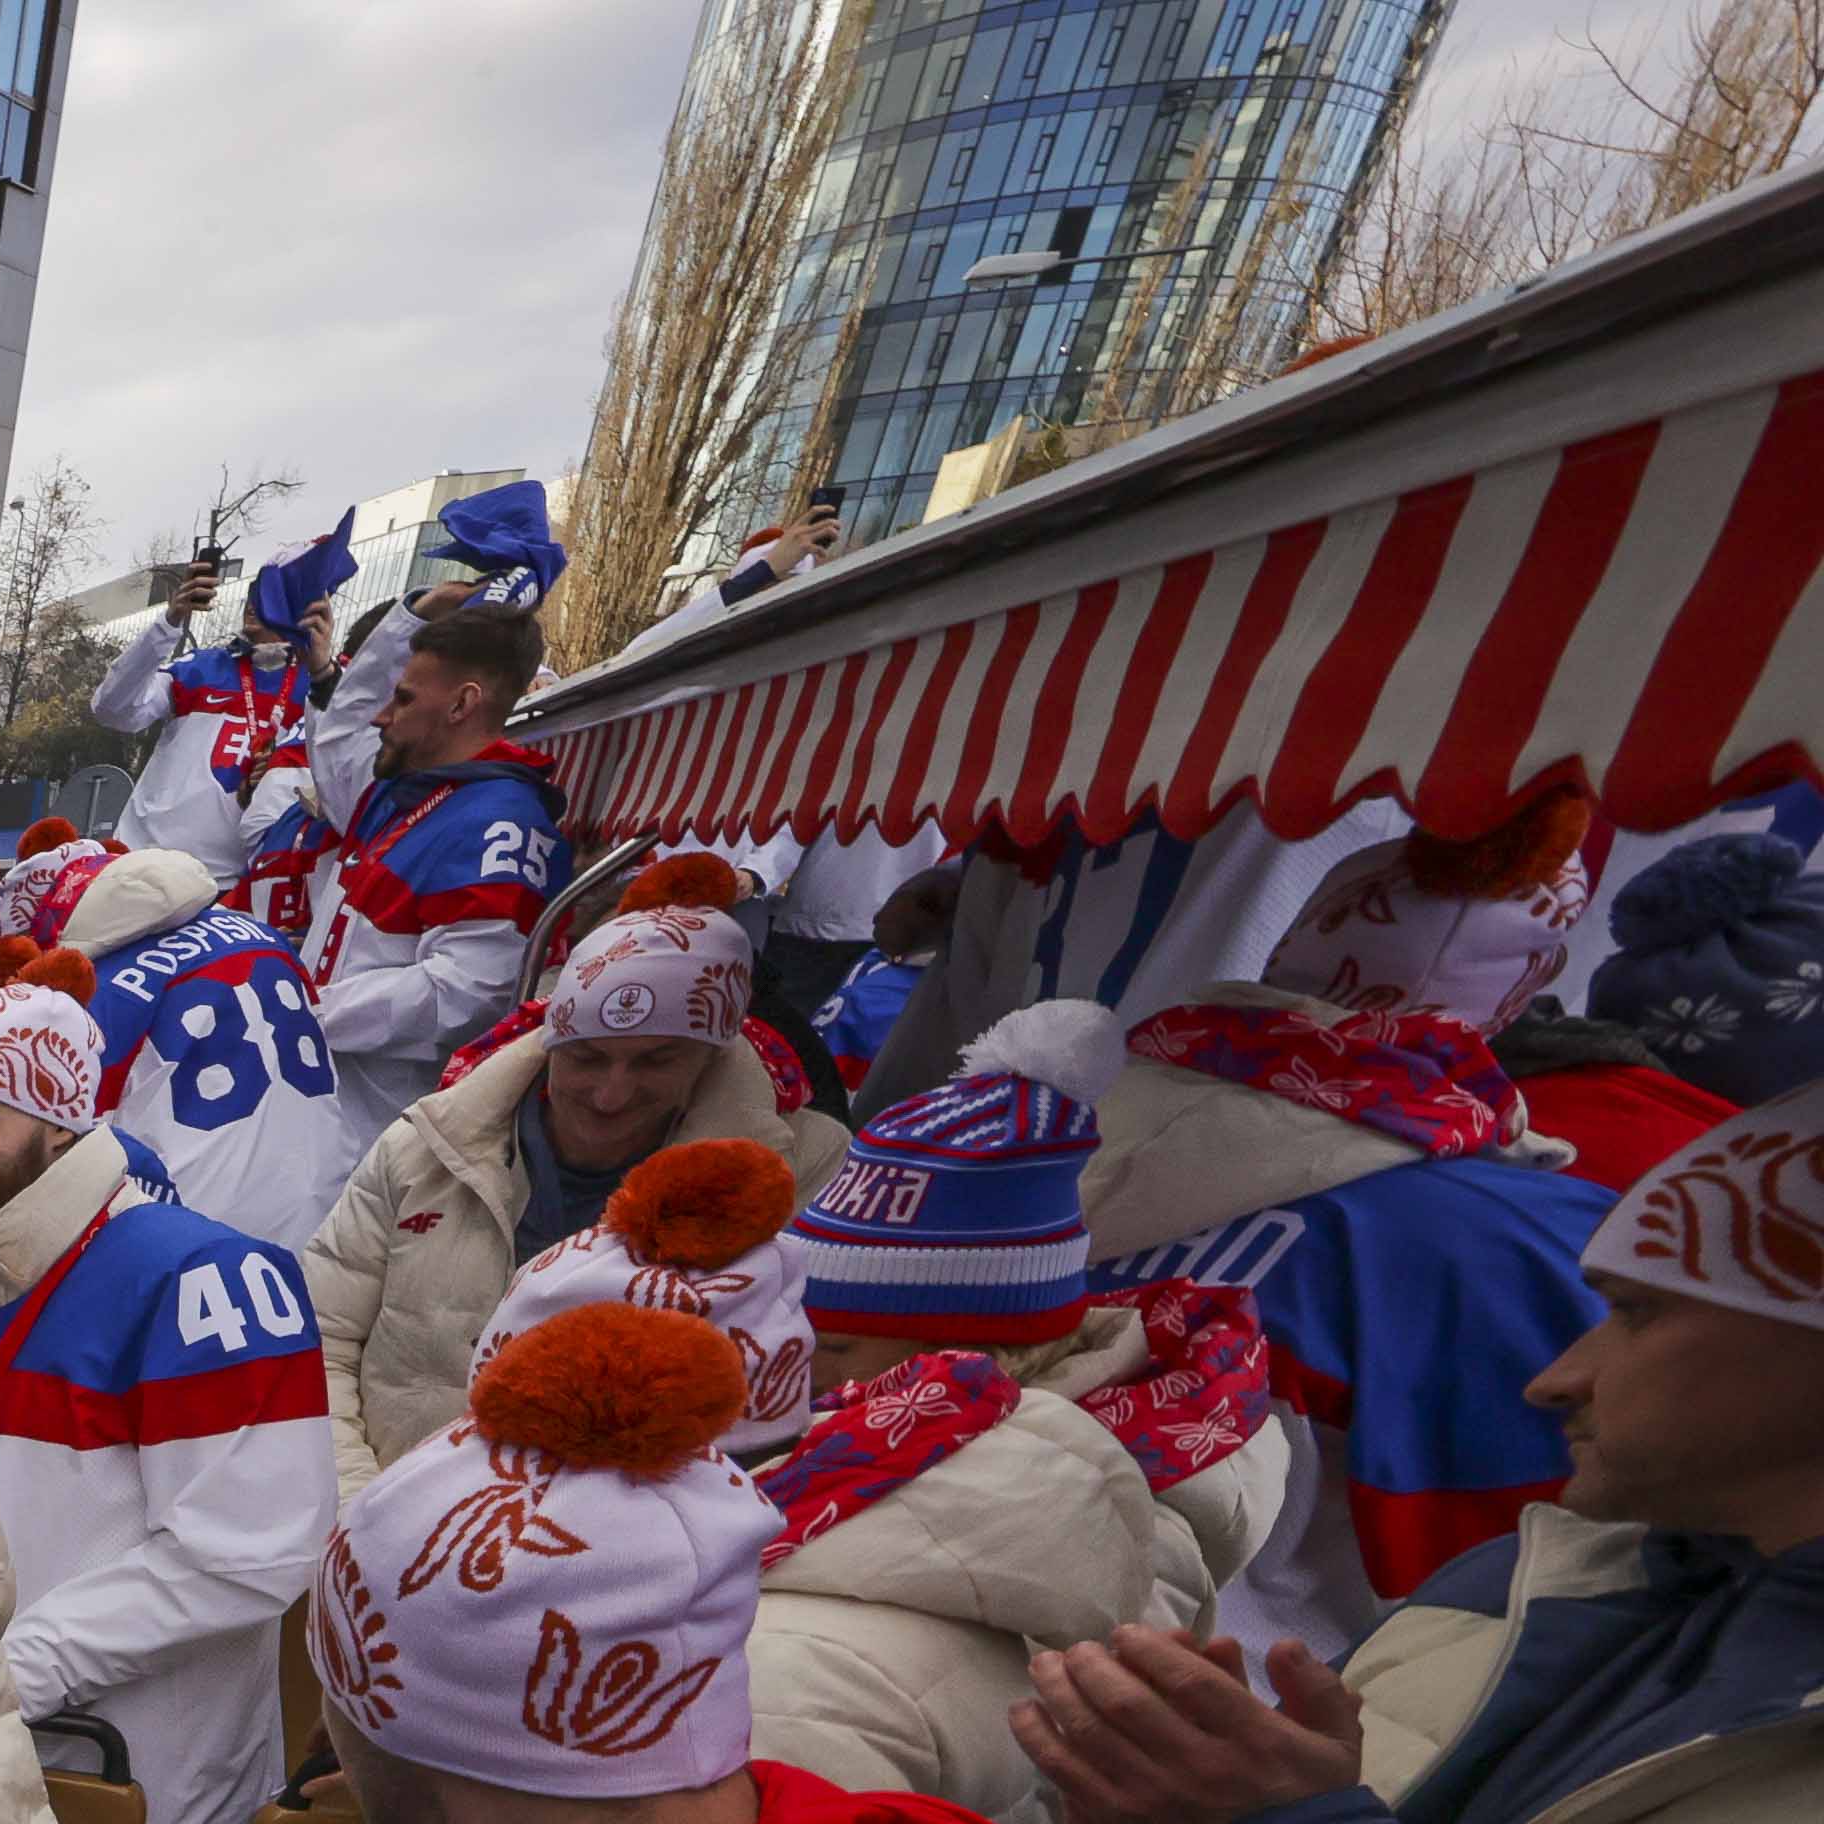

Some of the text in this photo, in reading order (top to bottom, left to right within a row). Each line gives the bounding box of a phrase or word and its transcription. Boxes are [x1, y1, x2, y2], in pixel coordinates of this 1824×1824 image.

[480, 821, 557, 889] 25
[149, 956, 336, 1132] 88
[177, 1250, 305, 1353] 40
